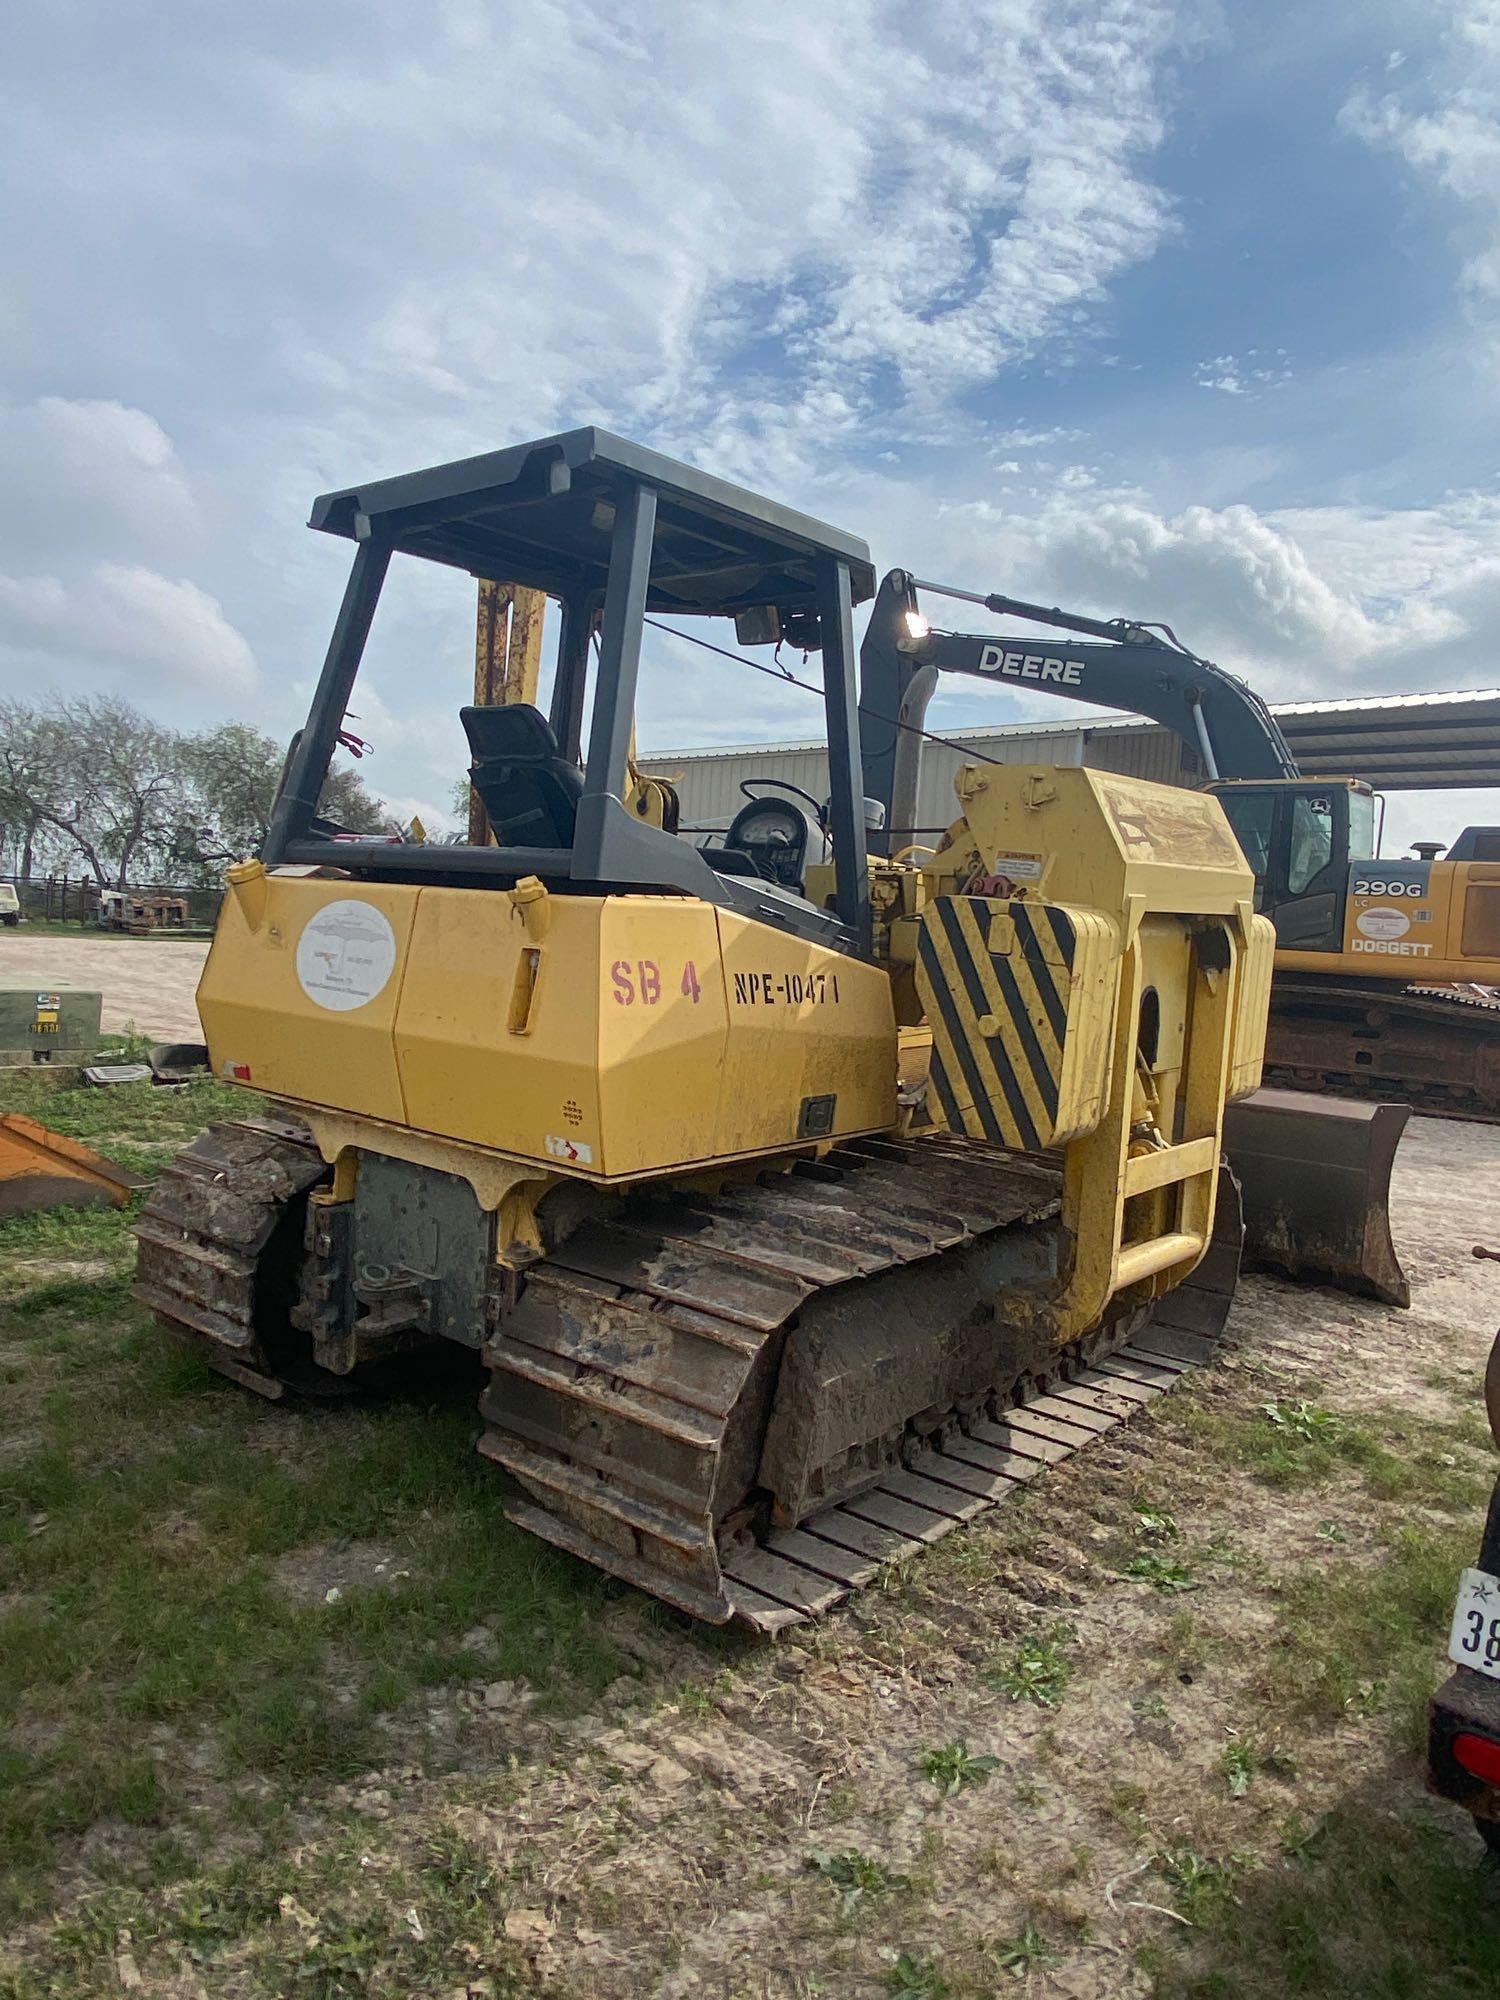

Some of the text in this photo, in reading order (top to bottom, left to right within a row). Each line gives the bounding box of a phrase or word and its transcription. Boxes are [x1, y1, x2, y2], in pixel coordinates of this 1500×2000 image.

[979, 645, 1085, 685] DEERE
[1354, 880, 1422, 898] 290G
[1354, 899, 1368, 907] LC
[1352, 939, 1433, 957] DOGGETT
[611, 960, 701, 1006] SB 4
[734, 973, 839, 1004] NPE-10471
